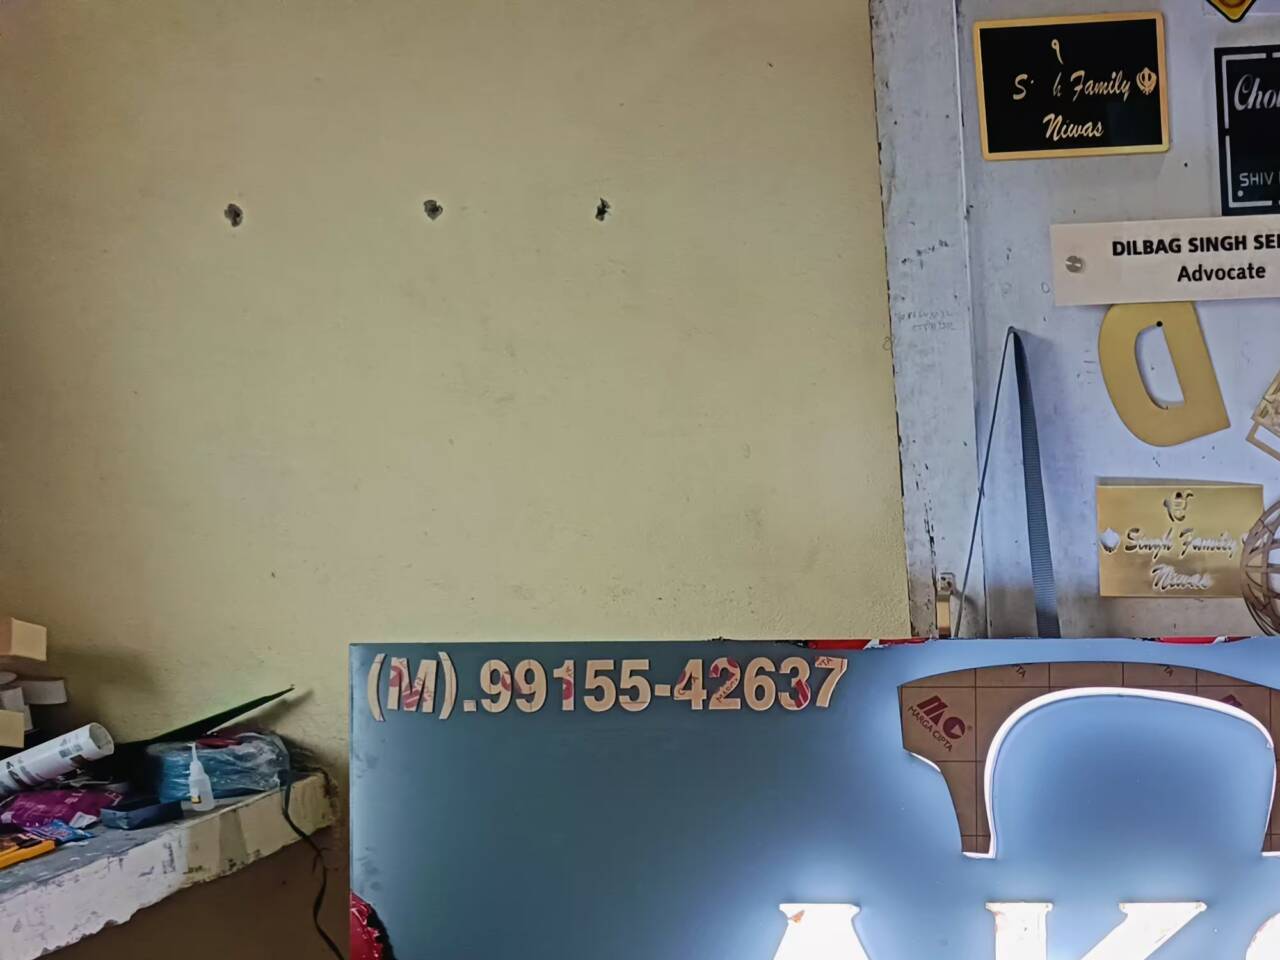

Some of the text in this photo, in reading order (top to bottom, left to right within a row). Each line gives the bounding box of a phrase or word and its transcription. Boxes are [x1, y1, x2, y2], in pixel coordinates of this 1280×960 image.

[1070, 70, 1131, 102] Family
[1042, 112, 1104, 141] Niwas
[1240, 171, 1274, 187] SHIV
[1112, 238, 1182, 257] DILBAG
[1187, 235, 1248, 253] SINGH
[1177, 263, 1266, 282] Advocate
[366, 652, 848, 720] (M).99155-42637
